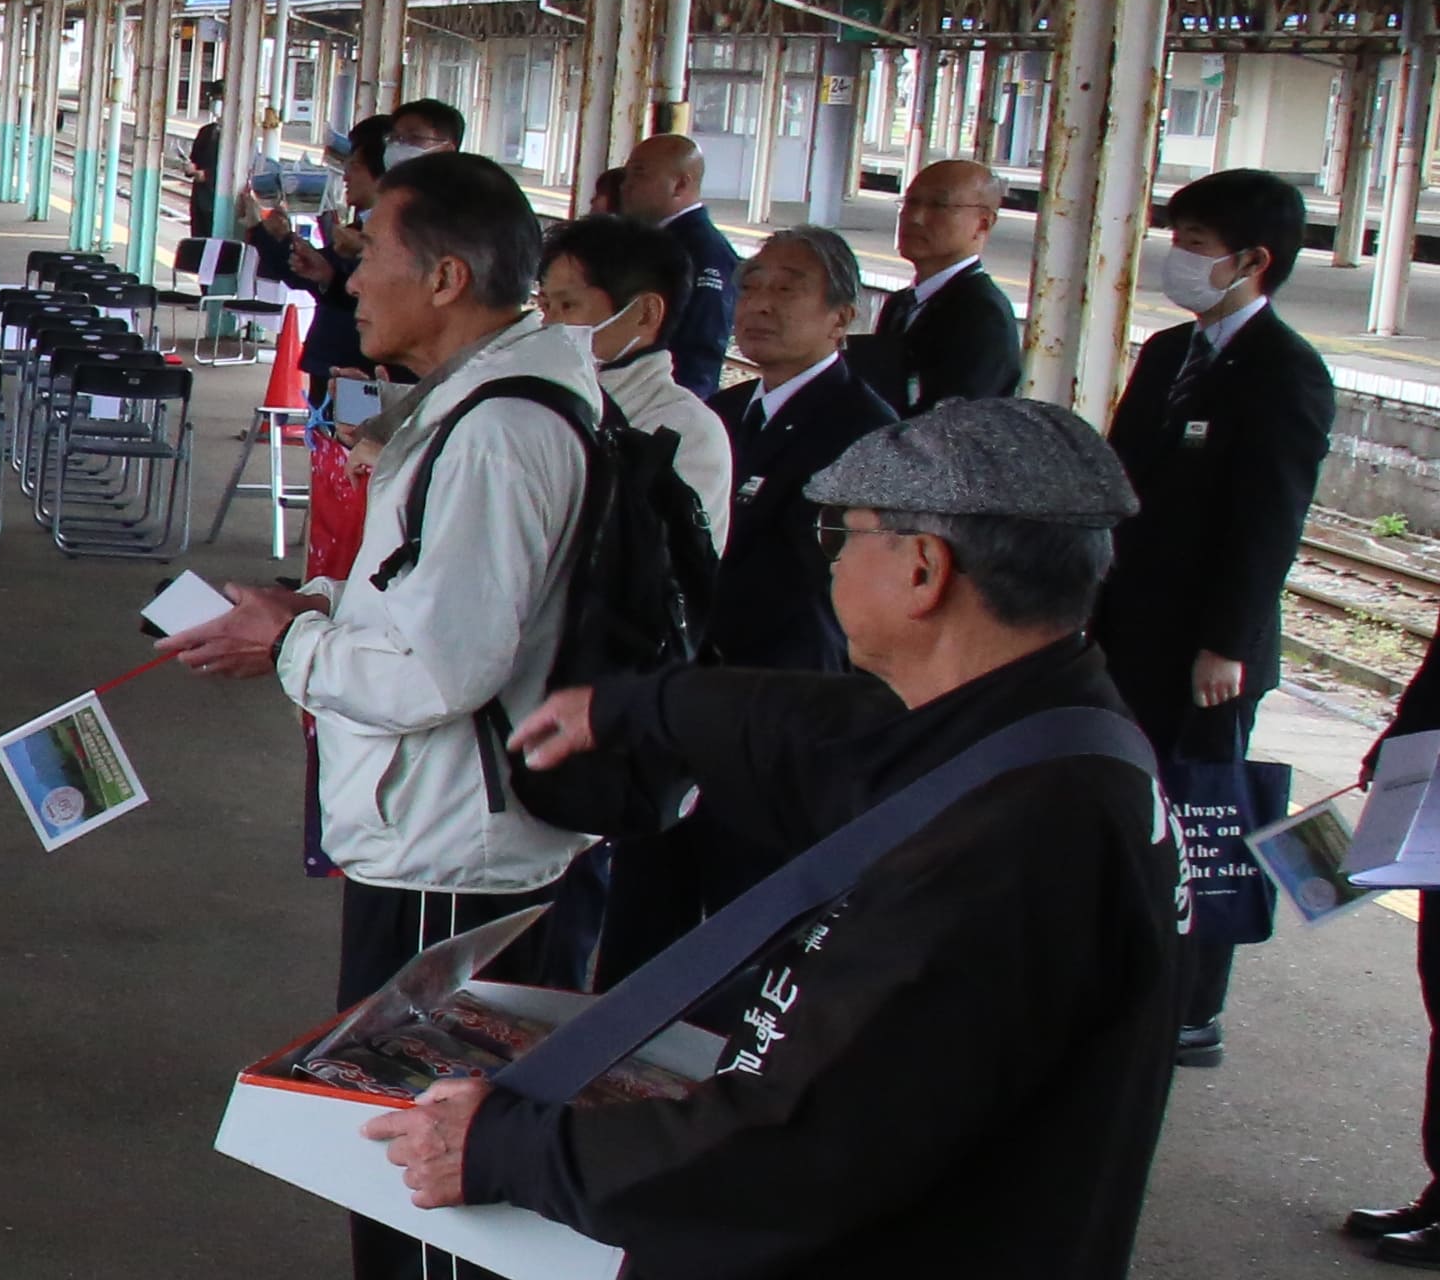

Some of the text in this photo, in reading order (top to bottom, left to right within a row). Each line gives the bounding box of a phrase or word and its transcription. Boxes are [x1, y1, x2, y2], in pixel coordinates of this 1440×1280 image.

[1217, 825, 1240, 836] on
[1188, 844, 1219, 858] the
[1218, 863, 1258, 877] side
